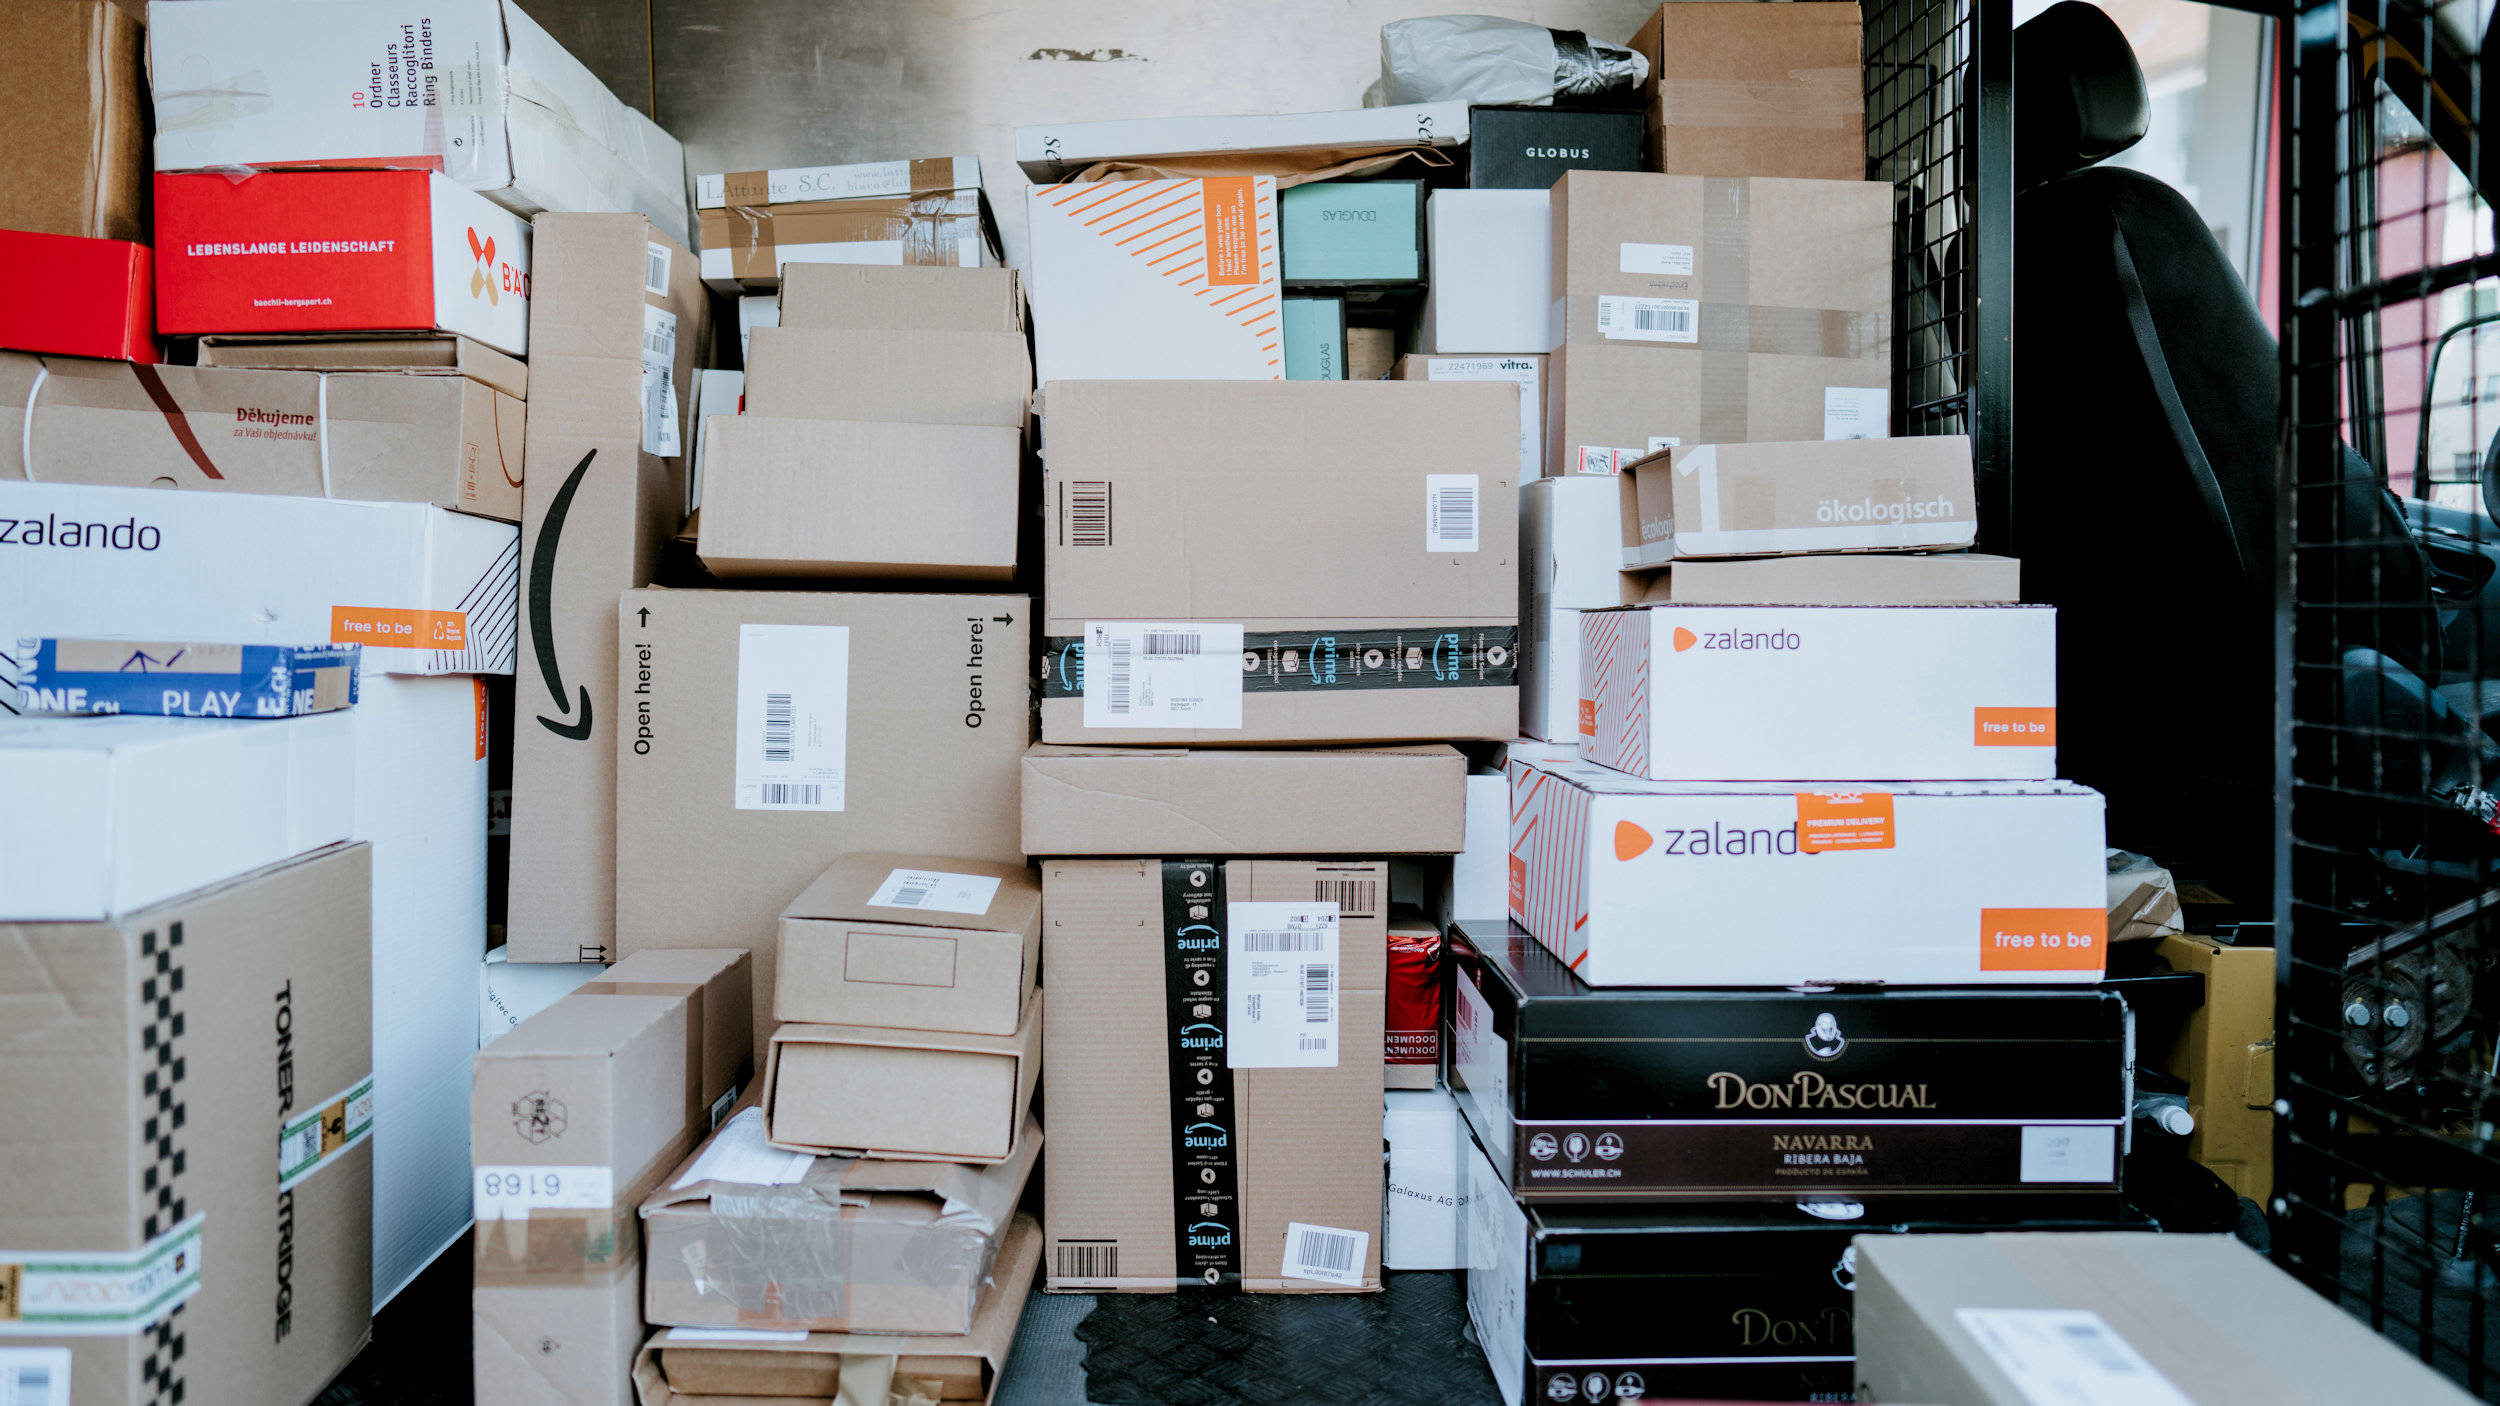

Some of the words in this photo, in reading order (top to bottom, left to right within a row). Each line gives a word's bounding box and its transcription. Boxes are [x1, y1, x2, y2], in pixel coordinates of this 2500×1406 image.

[419, 18, 433, 70] Binders
[387, 43, 400, 108] Classeurs
[401, 25, 419, 107] Raccoglitori
[369, 62, 382, 108] Ordner
[422, 75, 438, 106] Ring
[352, 92, 365, 109] 10
[1526, 147, 1590, 159] GLOBUS
[799, 173, 836, 193] S.C.
[1236, 187, 1245, 208] again.
[1230, 204, 1237, 214] so
[1322, 210, 1377, 222] DOUGLAS
[1216, 218, 1224, 233] your
[1231, 215, 1237, 226] me
[1224, 232, 1232, 258] another
[1231, 227, 1240, 252] recycle
[1239, 231, 1245, 240] be
[187, 242, 287, 257] LEBENSLANGE
[290, 240, 395, 255] LEIDENSCHAFT
[1232, 253, 1240, 276] Please
[254, 297, 333, 308] baechli-bergsport.ch
[1448, 362, 1494, 371] 22471969
[1499, 359, 1533, 370] vitra.
[237, 407, 314, 428] Děkujeme
[233, 429, 243, 437] za
[245, 427, 262, 438] Vaši
[263, 429, 317, 442] objednávku!
[1816, 495, 1956, 524] ökologisch
[0, 513, 161, 552] zalando
[344, 619, 372, 633] free
[376, 621, 391, 634] to
[394, 622, 413, 634] be
[965, 617, 982, 667] here!
[1703, 628, 1801, 650] zalando
[634, 643, 652, 692] here!
[1321, 636, 1340, 684] prime
[1443, 633, 1463, 681] prime
[162, 689, 242, 718] PLAY
[965, 671, 983, 729] Open
[633, 695, 652, 756] Open
[1983, 721, 2010, 733] free
[2012, 722, 2026, 733] to
[2029, 721, 2046, 733] be
[1807, 819, 1844, 827] PREMIUM
[1846, 817, 1886, 826] DELIVERY
[1664, 820, 1820, 855] zaland
[1178, 935, 1220, 952] prime
[1994, 929, 2038, 949] free
[2041, 931, 2063, 949] to
[2067, 931, 2093, 949] be
[275, 979, 294, 1119] TONER
[1181, 1035, 1223, 1051] prime
[1185, 1133, 1227, 1150] prime
[1772, 1135, 1875, 1151] NAVARRA
[1783, 1153, 1831, 1166] RIBERA
[1833, 1153, 1864, 1167] BAJA
[1530, 1168, 1622, 1179] WWW.SCHULER.CH
[1774, 1167, 1821, 1176] PRODUCTO
[1835, 1166, 1869, 1176] ESPAÑA
[484, 1172, 561, 1197] 6168
[1388, 1183, 1433, 1202] Galaxus
[1436, 1195, 1454, 1207] AG
[275, 1123, 294, 1345] TRIDGE
[1188, 1232, 1231, 1250] prime
